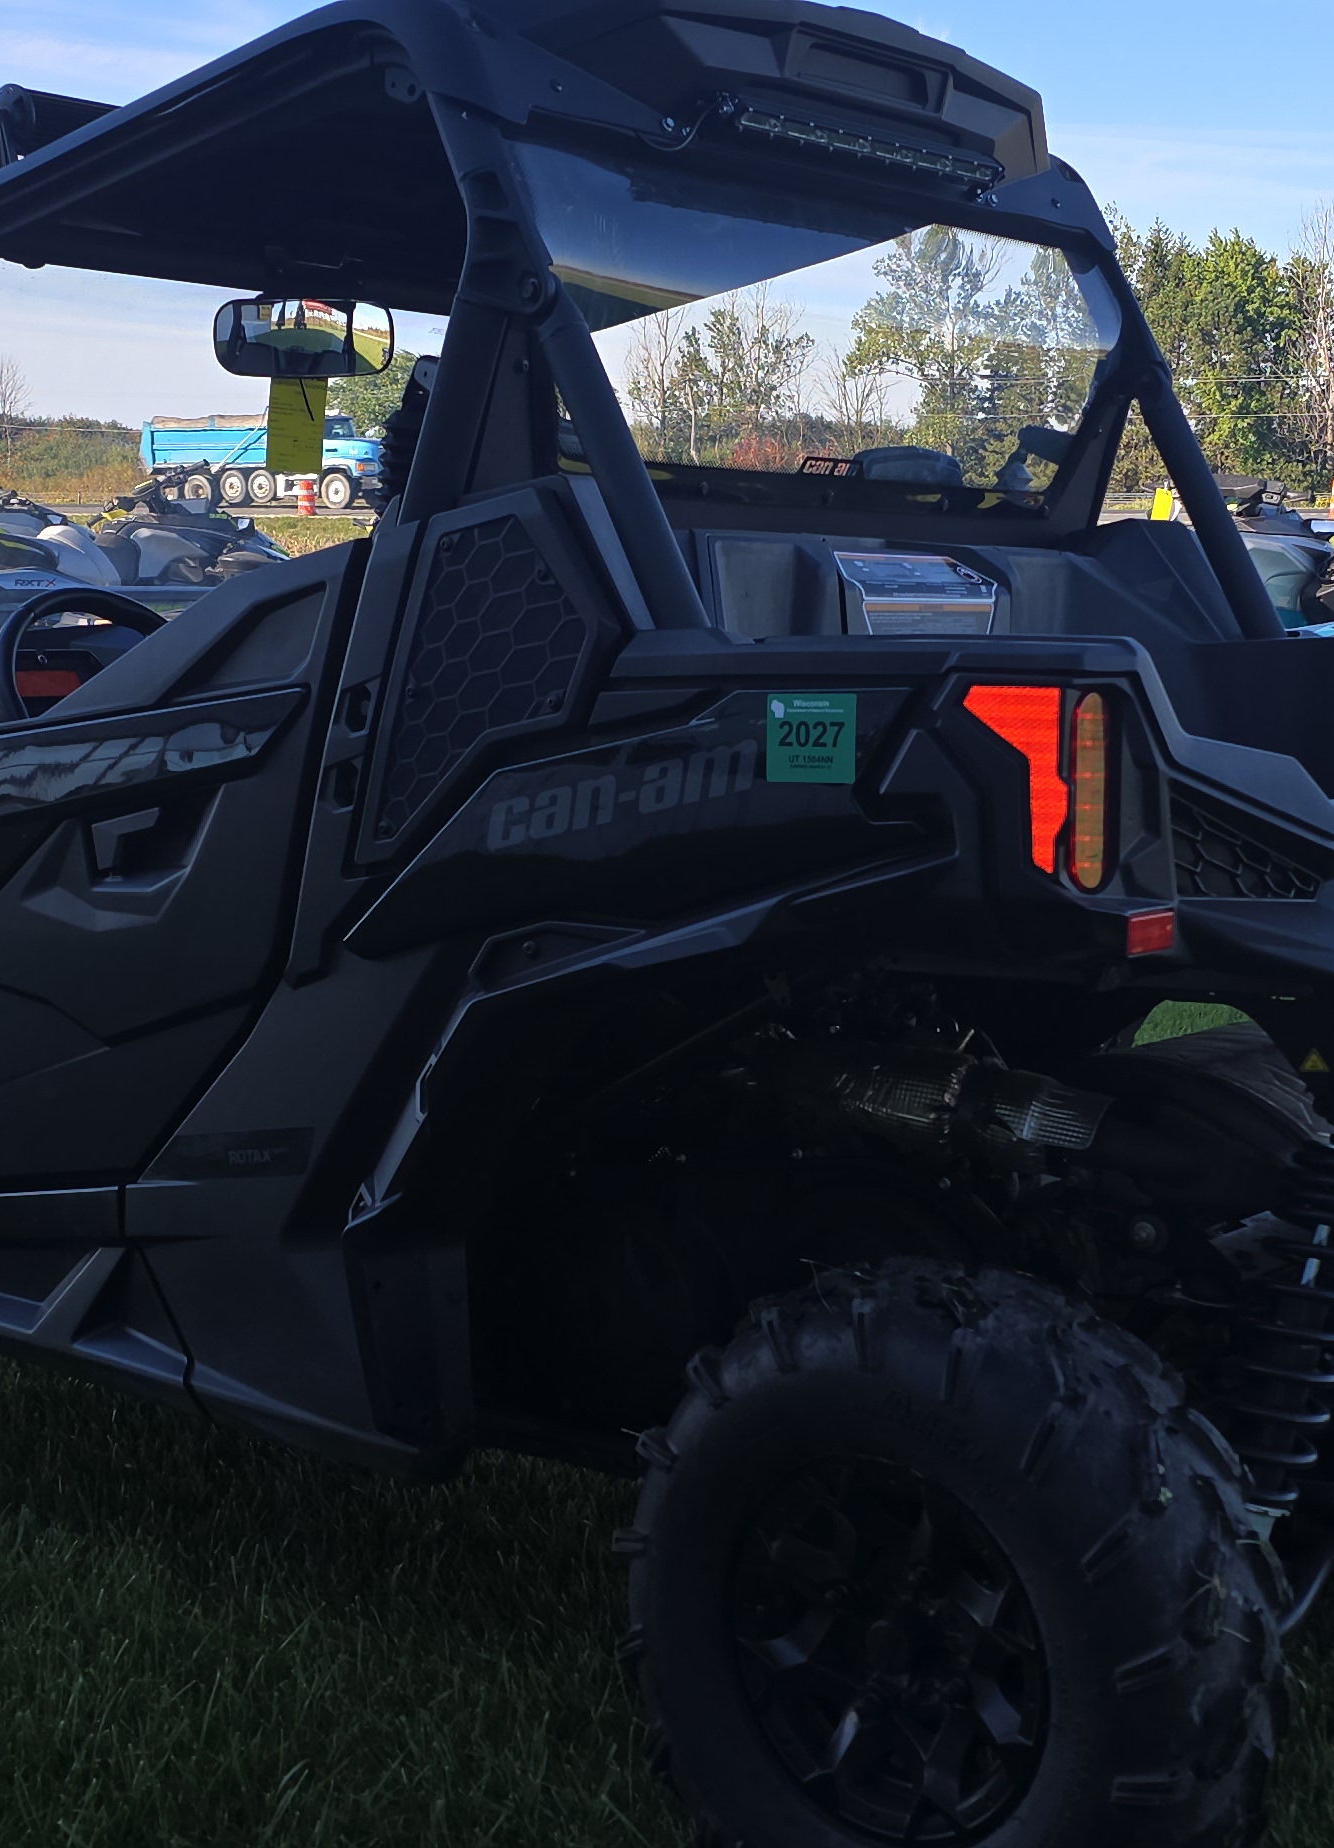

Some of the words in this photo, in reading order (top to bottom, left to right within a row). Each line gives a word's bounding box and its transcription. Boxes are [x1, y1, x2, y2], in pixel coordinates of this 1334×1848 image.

[792, 700, 830, 708] Wisconsin
[778, 720, 845, 749] 2027
[788, 755, 801, 764] UT
[486, 739, 758, 851] can-am
[228, 1150, 271, 1164] ROTAX
